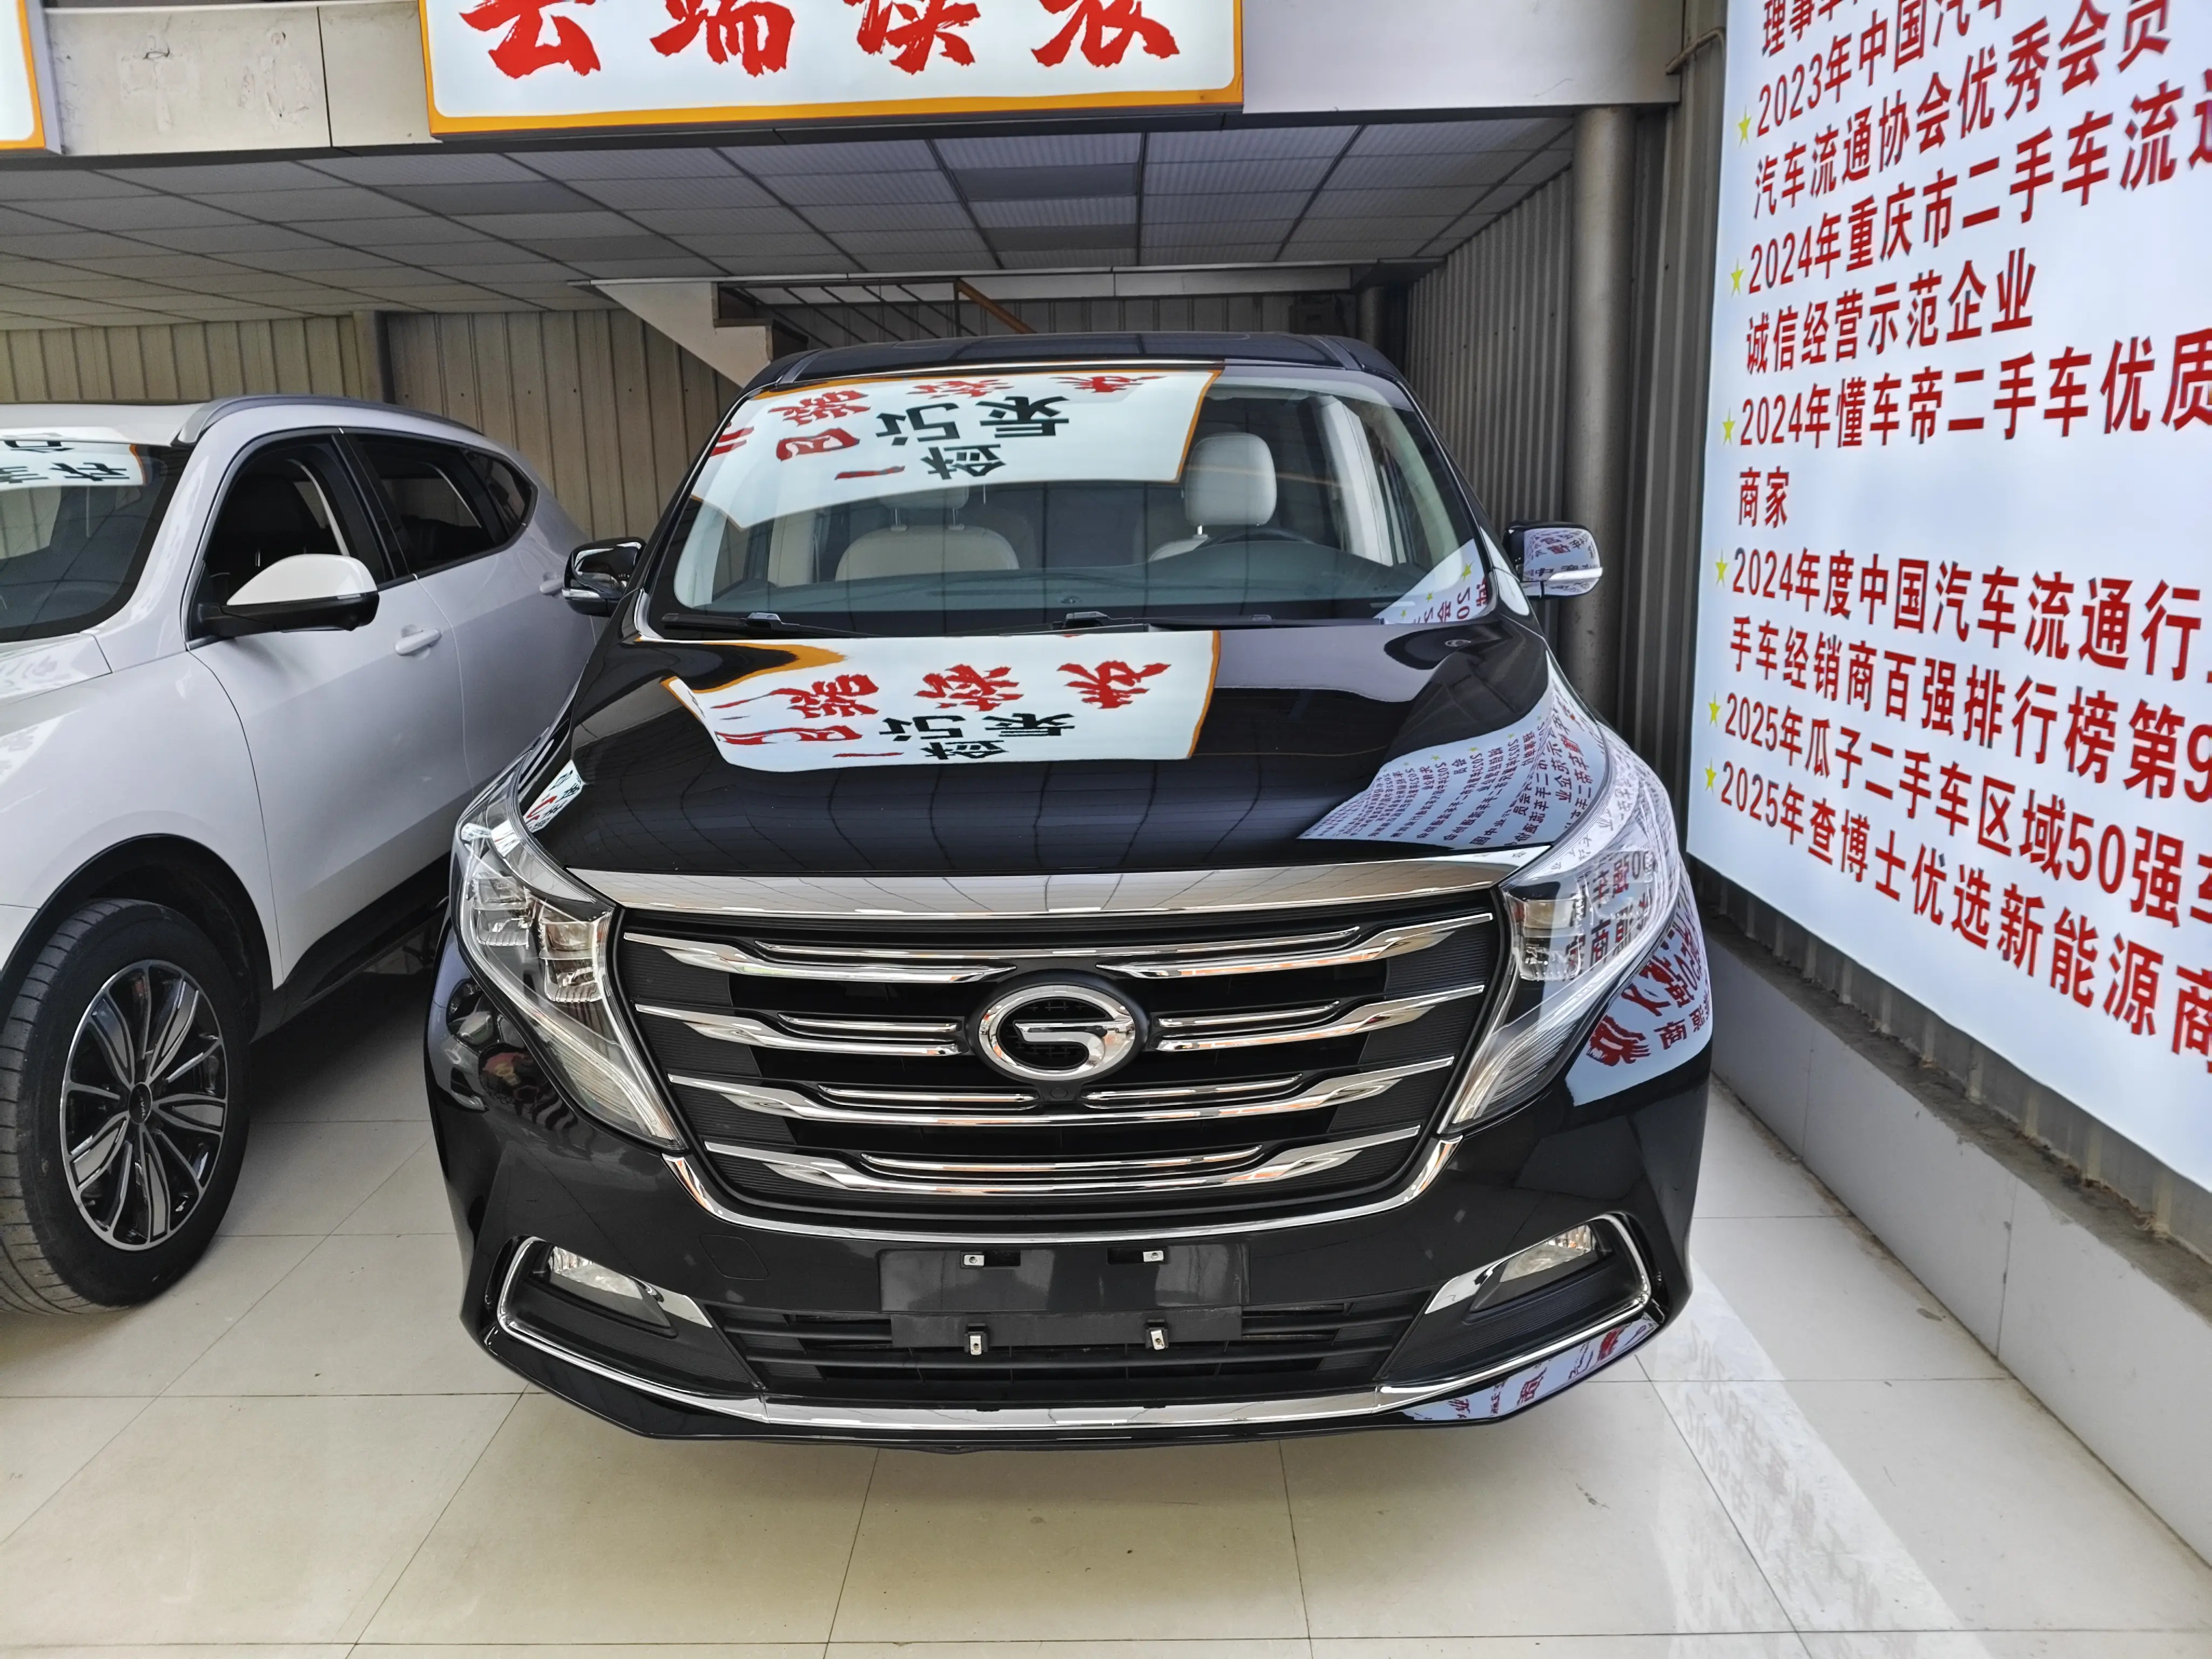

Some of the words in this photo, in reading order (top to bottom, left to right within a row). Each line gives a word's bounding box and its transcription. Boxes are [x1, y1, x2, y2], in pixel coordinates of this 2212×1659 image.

[1762, 0, 1858, 57] 理事
[1754, 0, 2172, 218] 汽车流通协会优秀会员
[1746, 247, 2036, 375] 诚信经营示范企业
[1740, 327, 2212, 448] 2024年懂车帝二手车优质
[1738, 466, 1790, 528] 商家
[1732, 547, 2212, 683] 2024年度中国汽车流通行
[1730, 615, 2212, 802] 手车经销商百强排行榜第9
[1721, 761, 2212, 1074] 2025年查博士优选新能源商
